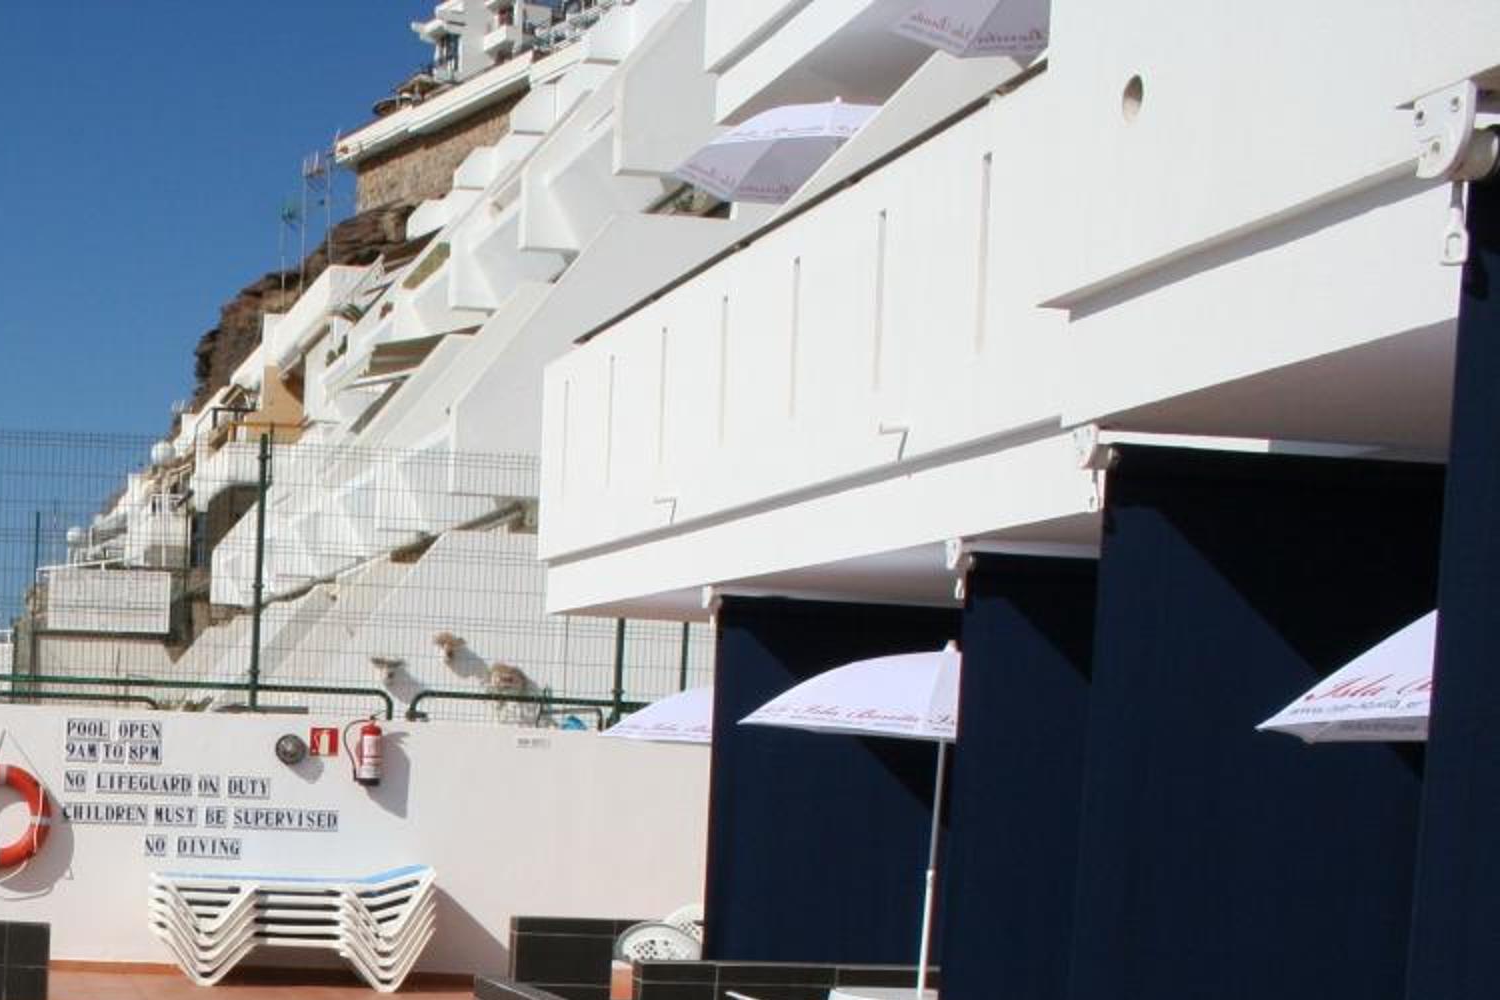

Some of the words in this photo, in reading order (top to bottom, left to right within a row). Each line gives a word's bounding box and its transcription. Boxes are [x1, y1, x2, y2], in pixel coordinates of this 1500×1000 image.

[67, 720, 109, 738] POOL
[118, 722, 160, 739] OPEN
[66, 743, 98, 758] 9AM
[103, 743, 124, 759] TO
[128, 744, 160, 761] 8PM
[65, 772, 86, 786] NO
[97, 773, 192, 792] LIFEGUARD
[198, 778, 218, 793] ON
[227, 779, 268, 795] DUTY
[62, 804, 146, 821] CHILDREN
[155, 807, 195, 823] MUST
[204, 808, 225, 825] BE
[233, 809, 338, 829] SUPERVISED
[145, 837, 165, 852] NO
[177, 837, 240, 856] DIVING
